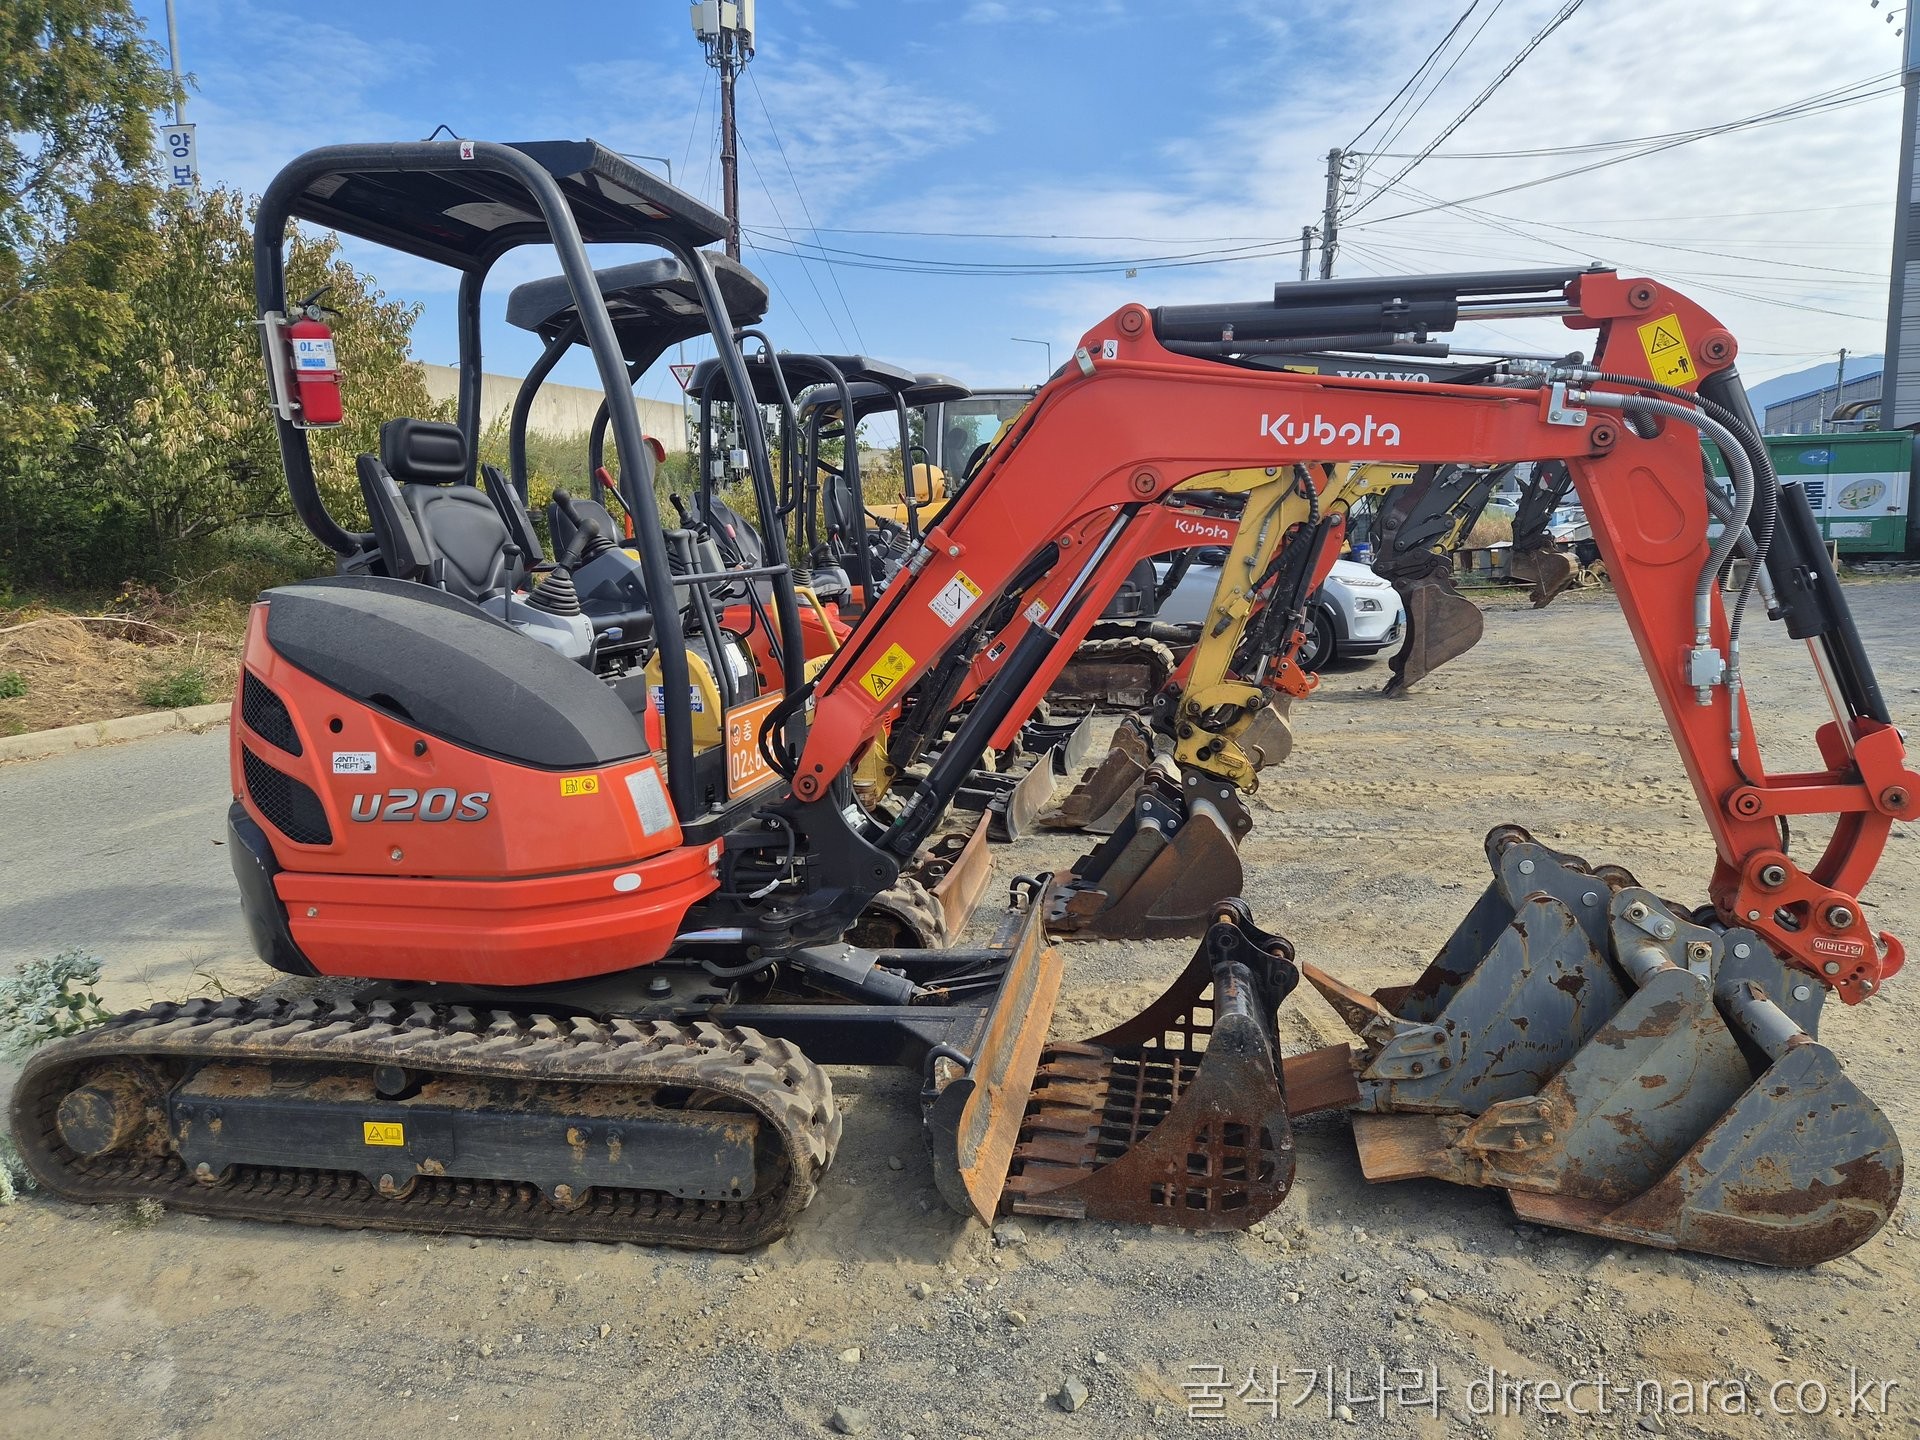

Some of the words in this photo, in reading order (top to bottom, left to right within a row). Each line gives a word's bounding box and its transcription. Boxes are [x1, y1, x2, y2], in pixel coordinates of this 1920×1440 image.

[1260, 414, 1400, 446] Kubota
[1175, 519, 1229, 540] Kubota
[334, 762, 359, 770] THEFT
